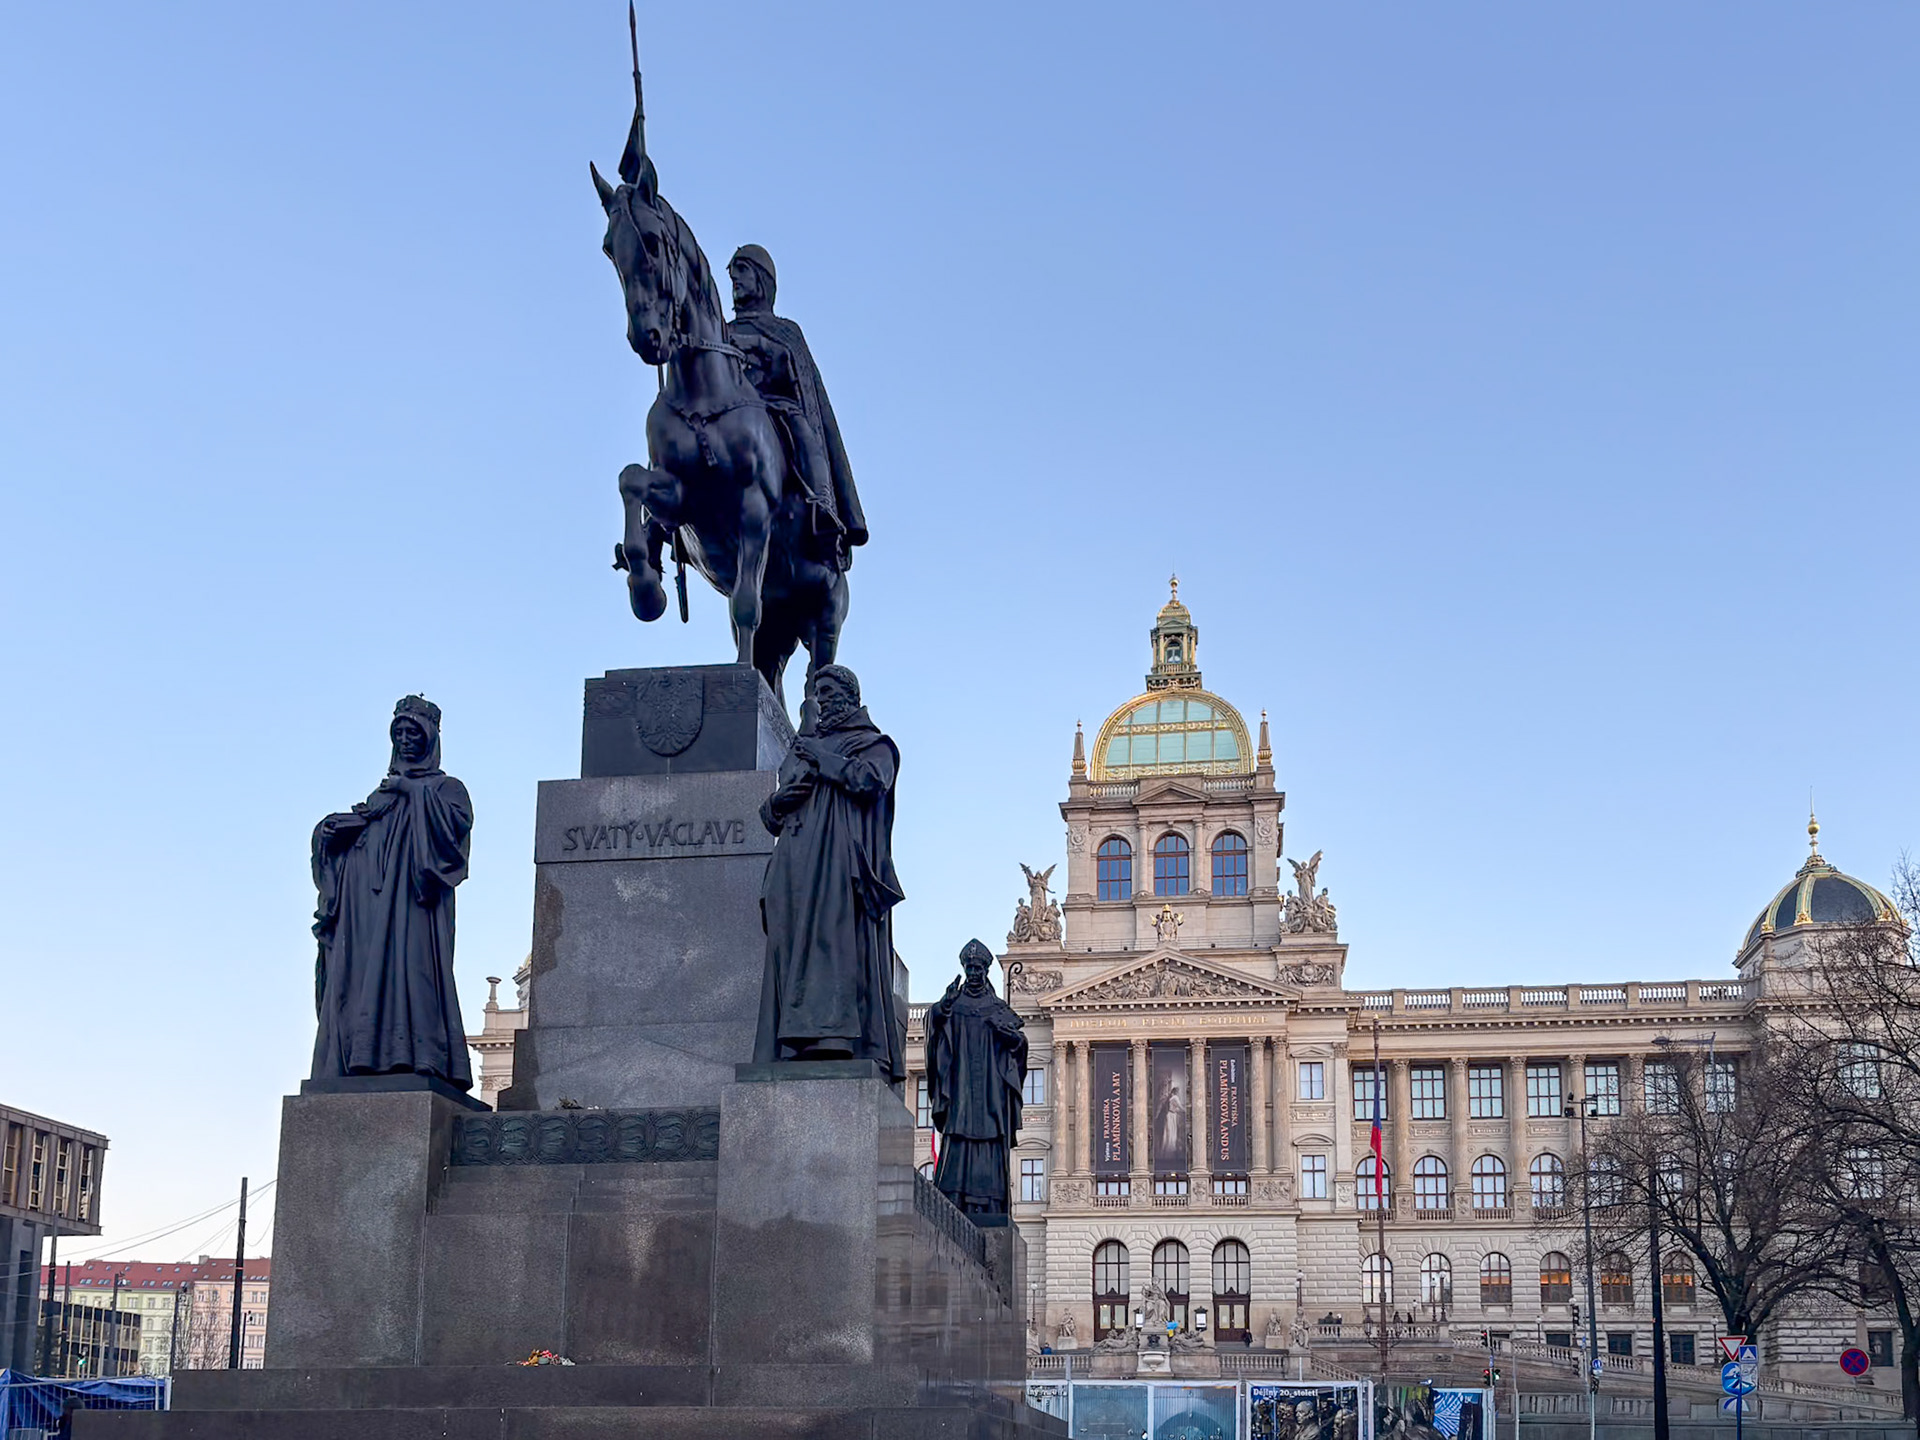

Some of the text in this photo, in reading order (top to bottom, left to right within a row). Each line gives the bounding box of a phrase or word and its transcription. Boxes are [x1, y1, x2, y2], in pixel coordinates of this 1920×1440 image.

[1111, 1097, 1120, 1162] PLAMÍNKOVÁ
[1219, 1059, 1230, 1161] PLAMÍNKOVÁ AND US
